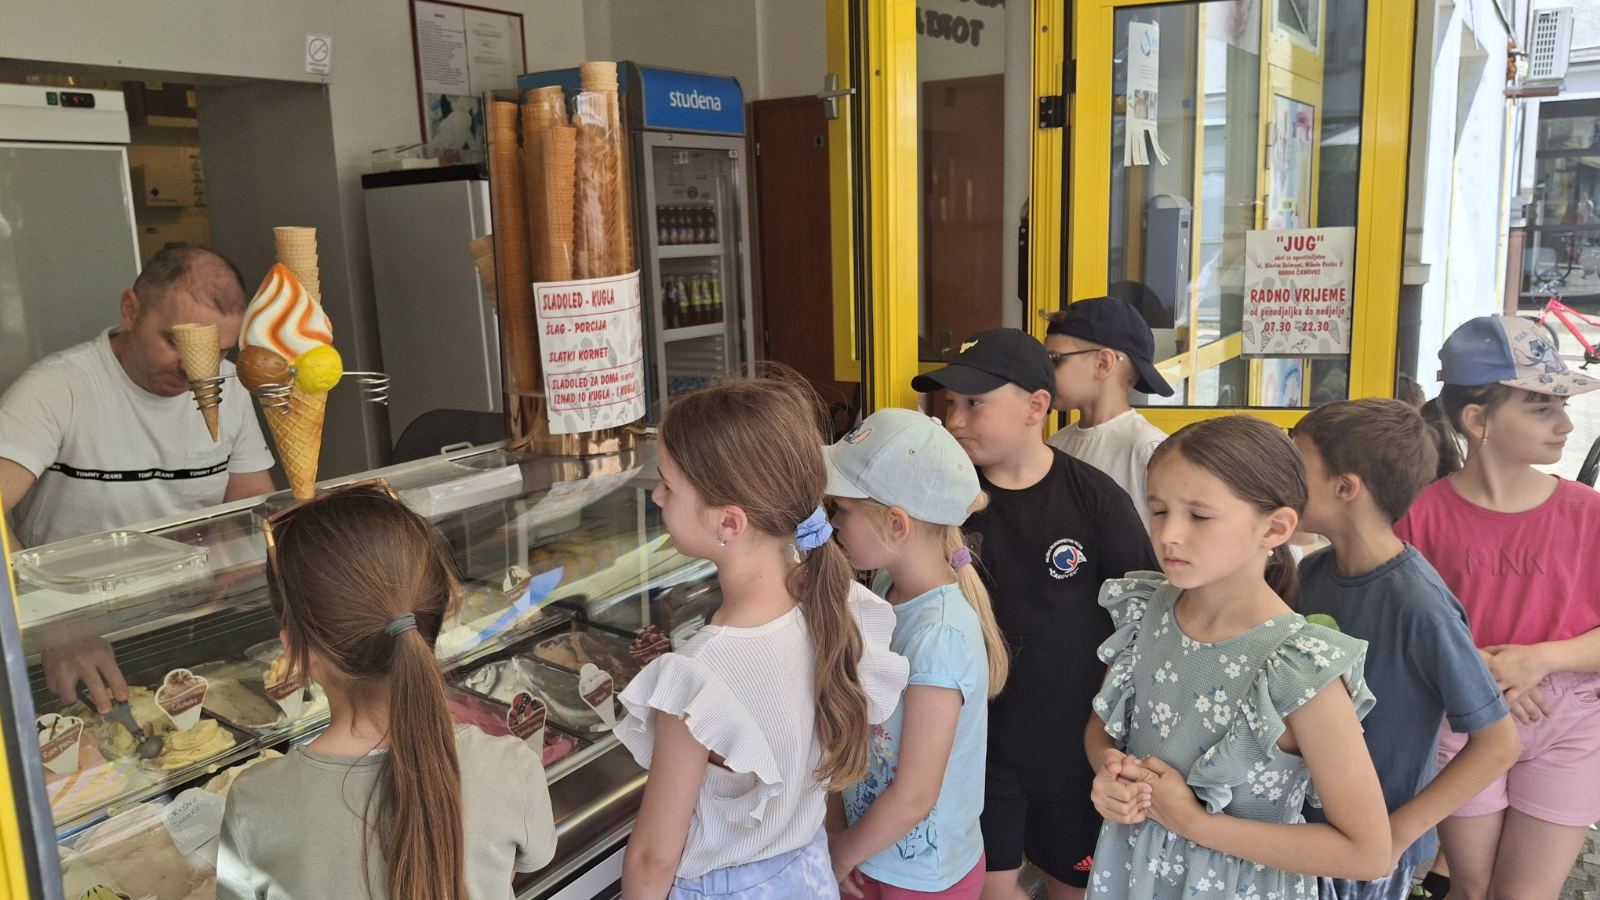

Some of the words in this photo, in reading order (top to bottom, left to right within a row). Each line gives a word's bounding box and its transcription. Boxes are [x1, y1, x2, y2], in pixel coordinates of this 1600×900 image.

[669, 89, 722, 111] studena
[1276, 235, 1325, 252] "JUG"
[543, 293, 583, 310] SLADOLED
[591, 288, 615, 308] KUGLA
[1250, 289, 1290, 303] RADNO
[1294, 288, 1346, 302] VRIJEME
[1250, 308, 1258, 317] od
[1261, 306, 1302, 318] ponedjeljka
[1305, 306, 1313, 315] do
[1316, 305, 1345, 318] nedjelje
[546, 323, 565, 335] ŠLAG
[575, 320, 607, 333] PORCIJA
[1264, 321, 1291, 332] 07.30
[1302, 321, 1329, 332] 22.30
[549, 351, 575, 363] SLATKI
[578, 347, 608, 361] KORNET
[552, 377, 588, 390] SLADOLED
[590, 376, 598, 386] ZA
[601, 373, 619, 385] DOMA
[554, 392, 576, 405] IZNAD
[578, 391, 586, 402] 10
[588, 389, 610, 402] KUGLA
[620, 384, 636, 398] KUGLA
[75, 471, 101, 479] TOMMY
[154, 471, 175, 479] JEANS
[1466, 546, 1545, 576] PINK
